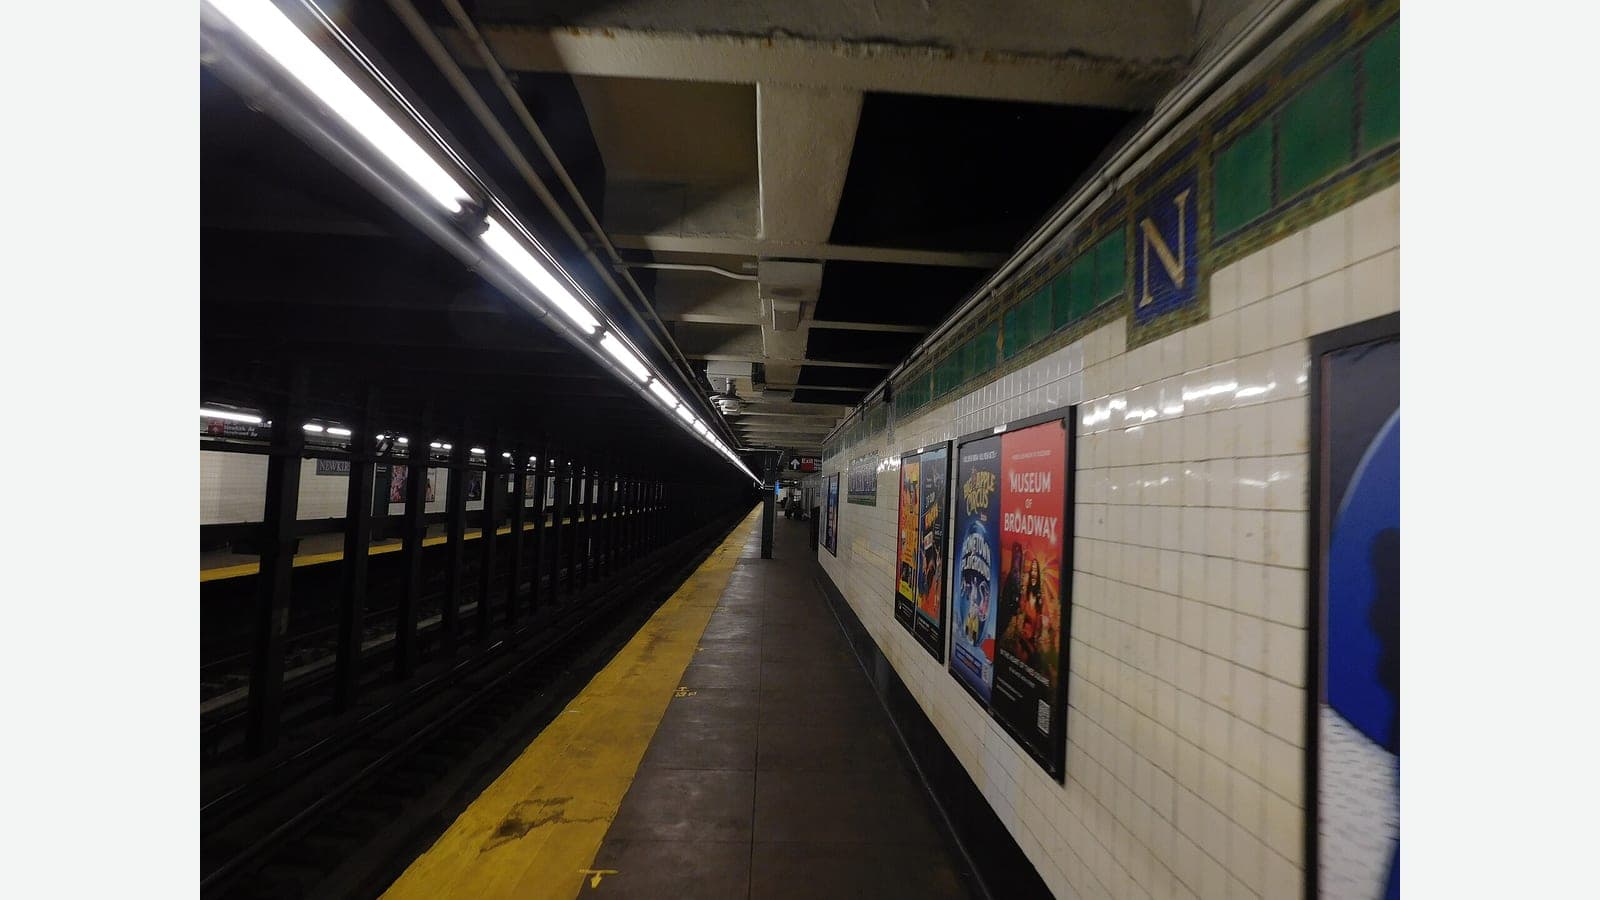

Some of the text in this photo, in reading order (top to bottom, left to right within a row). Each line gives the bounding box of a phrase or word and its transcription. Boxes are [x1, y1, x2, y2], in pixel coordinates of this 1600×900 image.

[1139, 188, 1191, 308] N
[1009, 469, 1052, 493] MUSEUM
[1024, 498, 1033, 509] OF
[1004, 511, 1058, 541] BROADWAY
